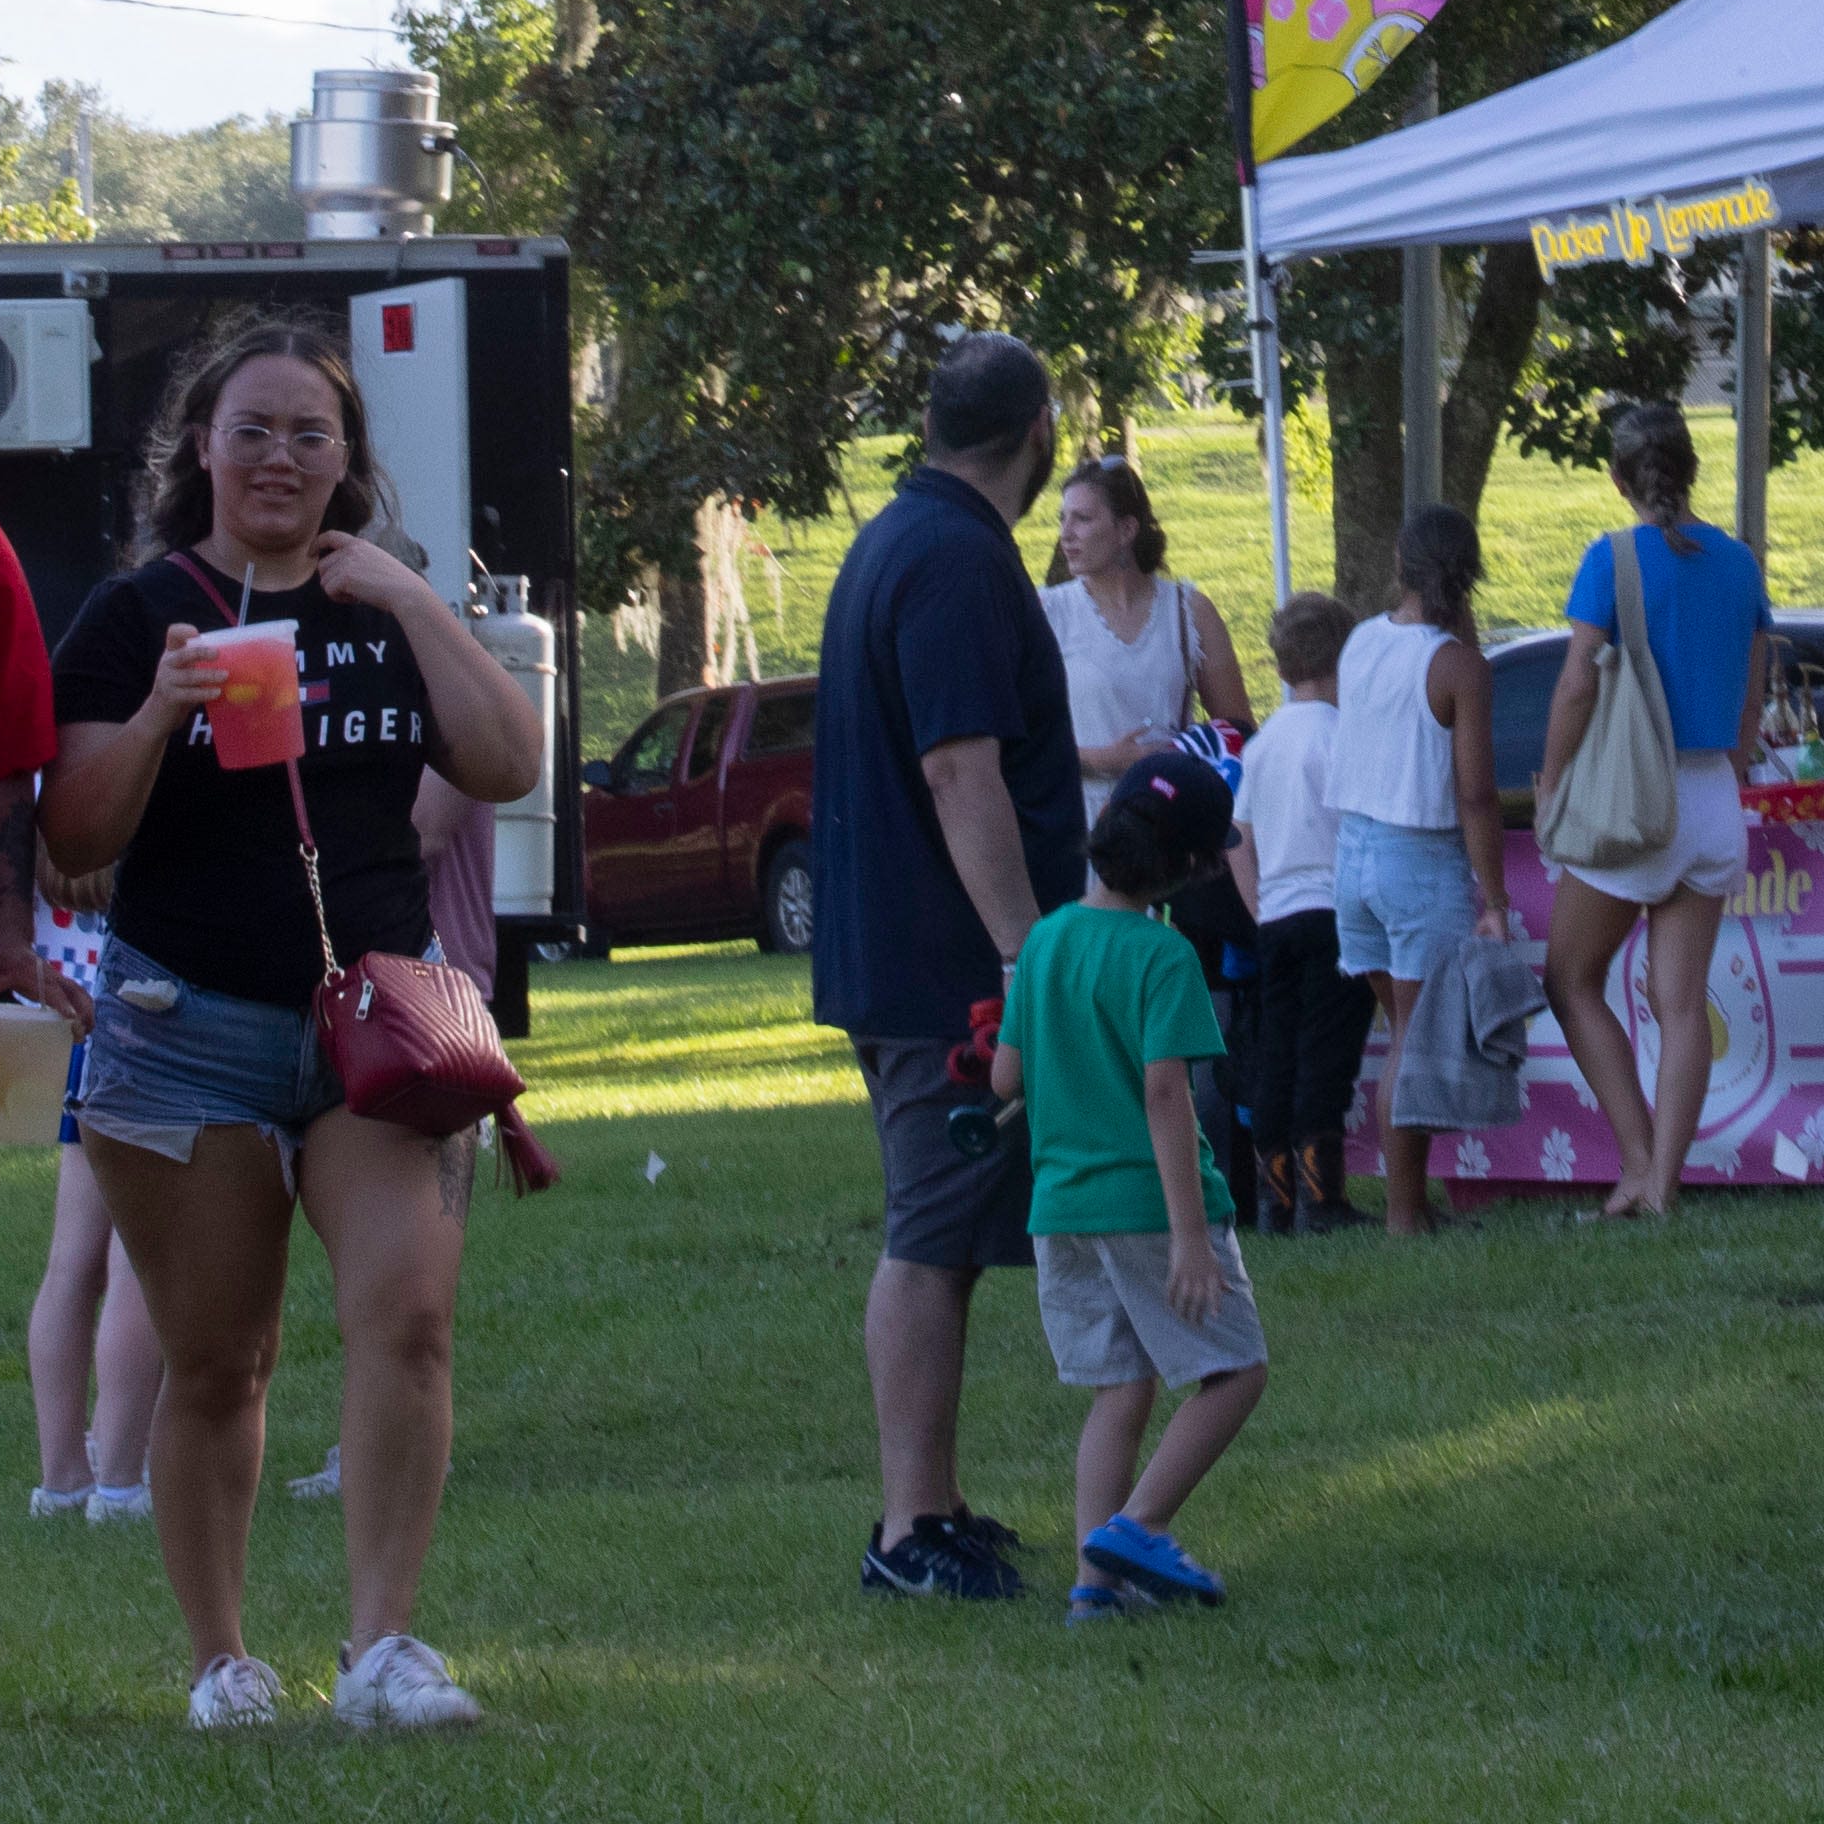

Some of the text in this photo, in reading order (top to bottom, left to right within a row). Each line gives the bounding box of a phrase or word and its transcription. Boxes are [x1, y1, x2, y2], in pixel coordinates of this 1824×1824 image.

[1530, 183, 1774, 278] Pucker Up Lemonade
